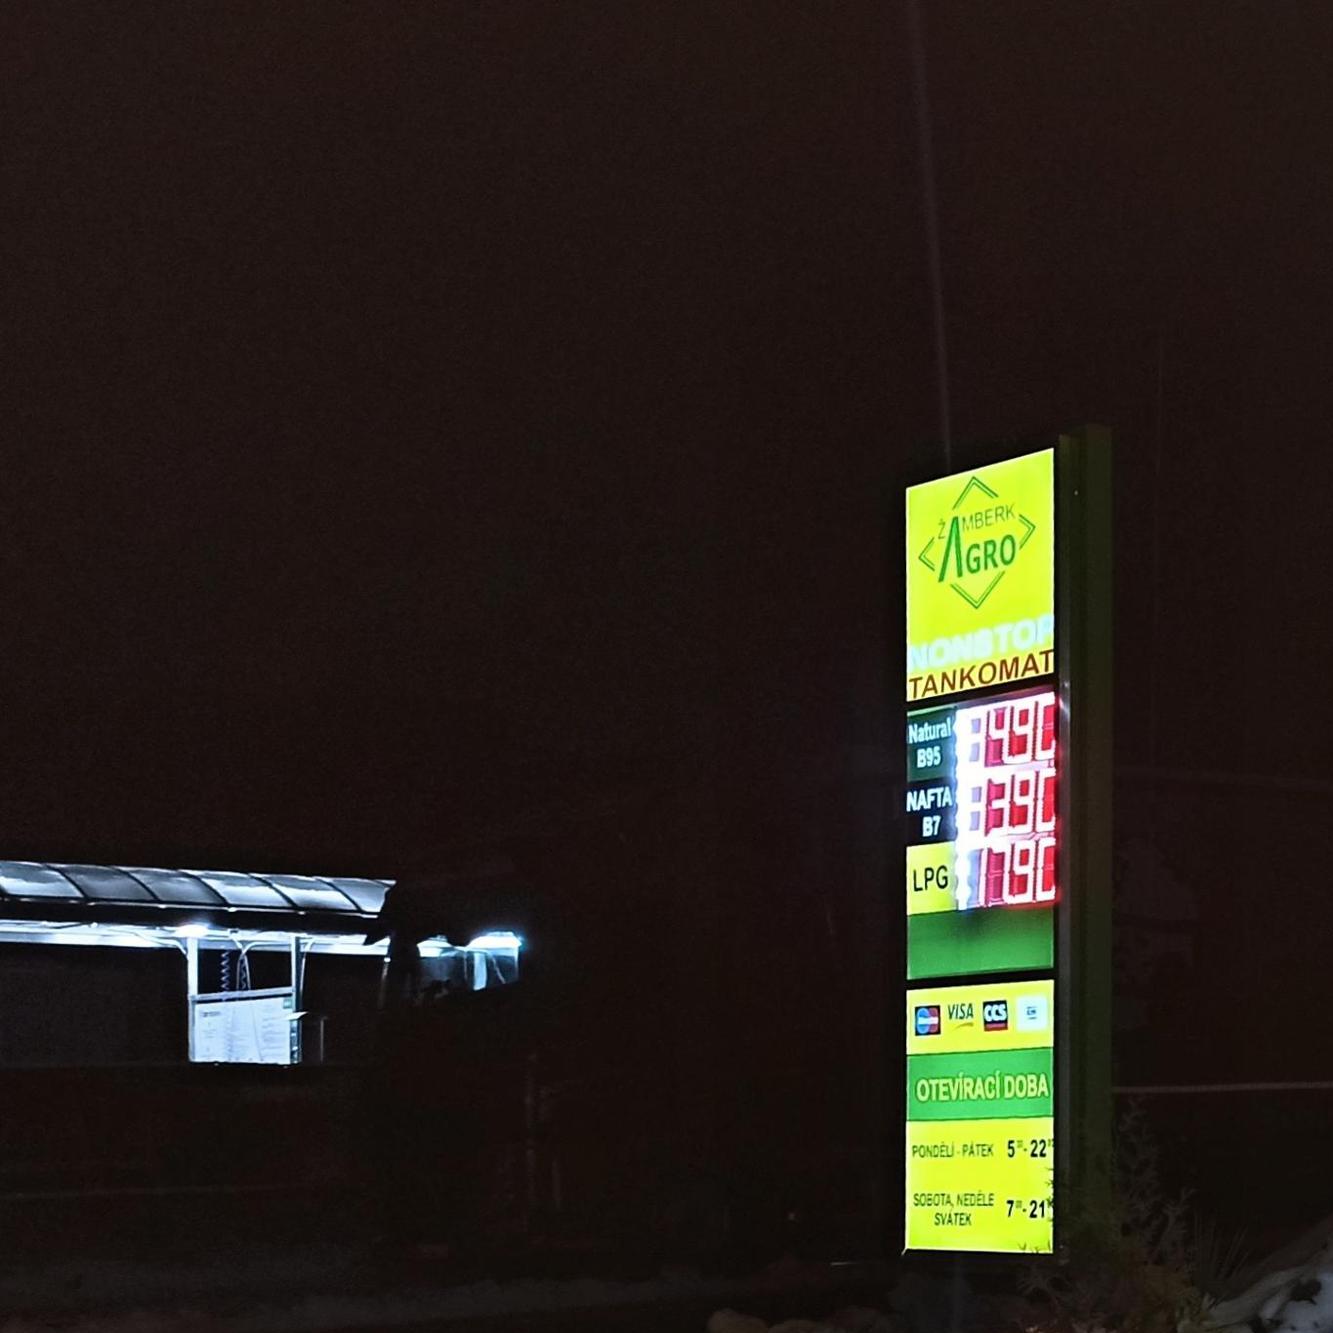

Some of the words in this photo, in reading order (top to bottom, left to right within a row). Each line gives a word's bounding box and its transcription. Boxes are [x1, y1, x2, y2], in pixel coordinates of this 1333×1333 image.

[909, 649, 1054, 698] TANKOMAT
[908, 717, 951, 744] Natural
[917, 746, 941, 768] B95
[906, 786, 953, 812] NAFTA
[922, 815, 941, 837] B7
[913, 865, 948, 892] LPG
[948, 1003, 974, 1020] VISA
[984, 1003, 1007, 1022] CCS
[916, 1071, 1000, 1102] OTEVÍRACÍ
[1004, 1073, 1049, 1099] DOBA
